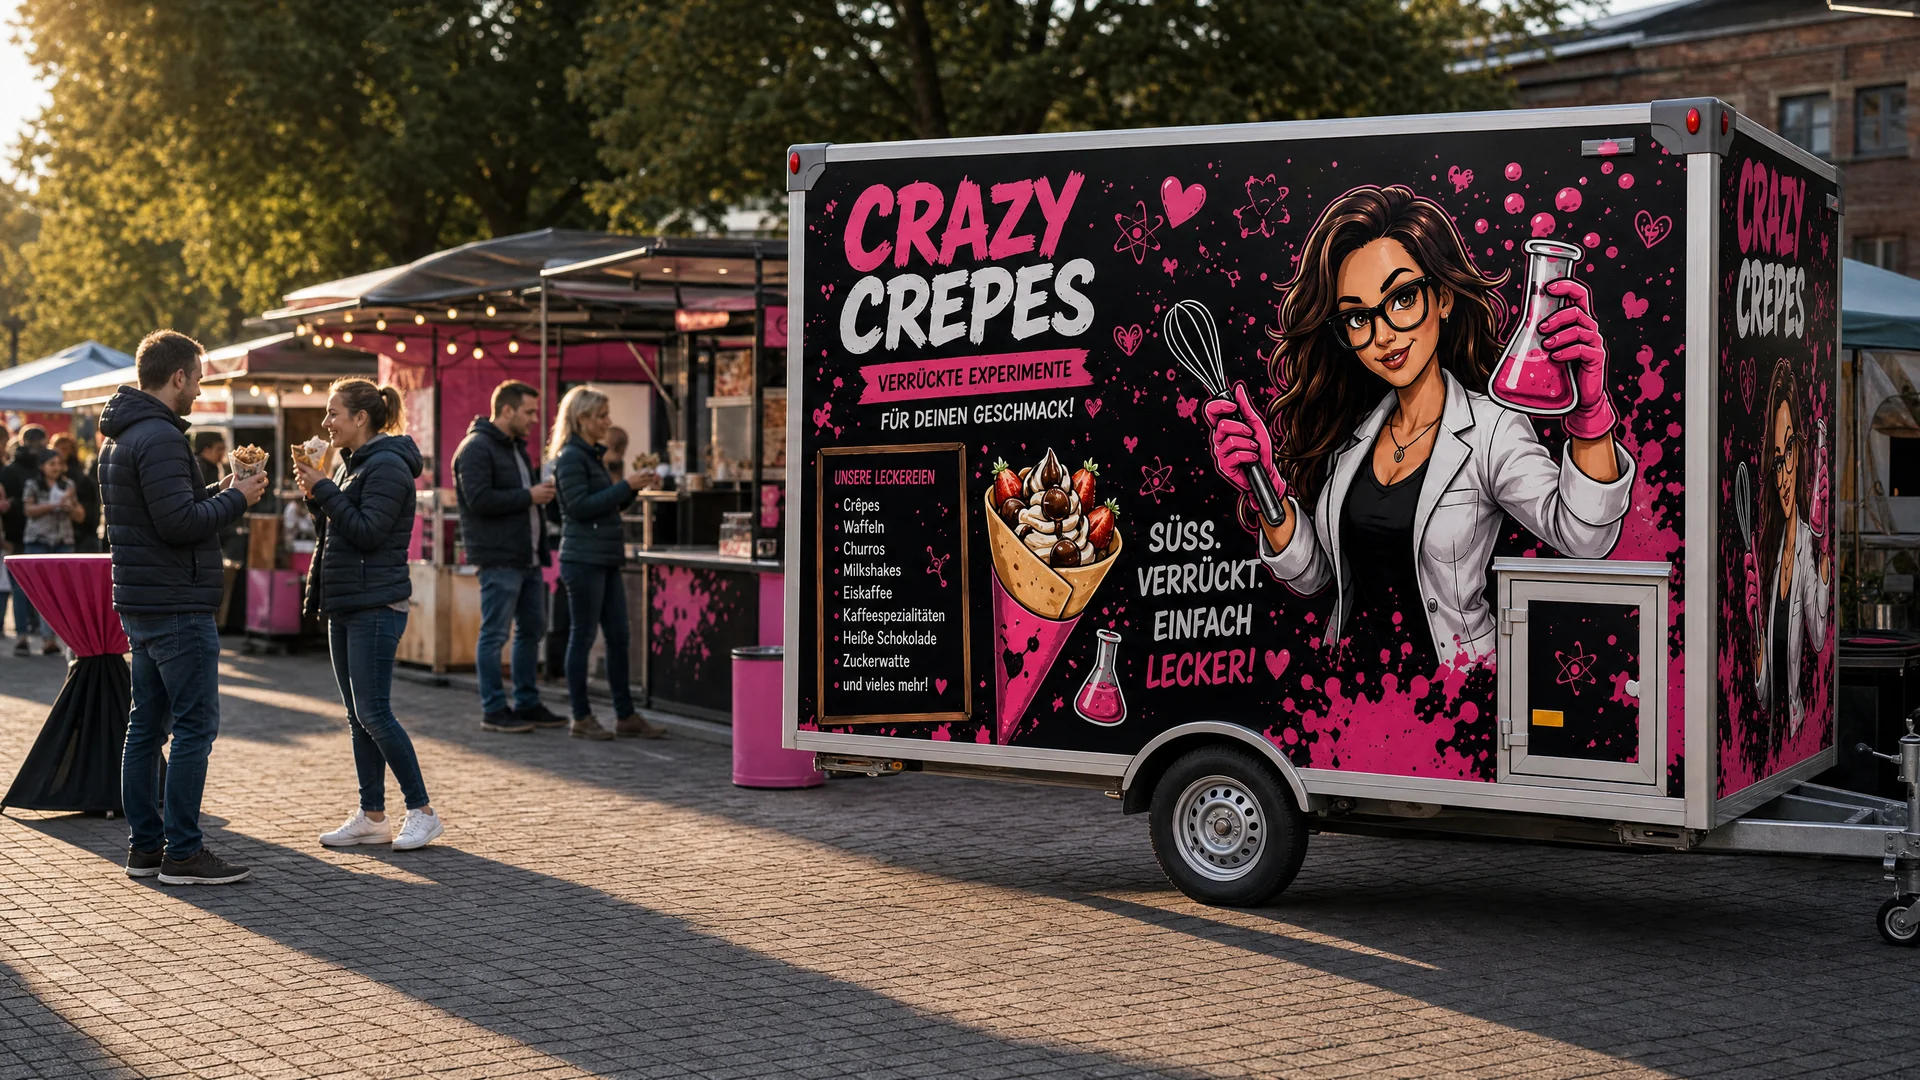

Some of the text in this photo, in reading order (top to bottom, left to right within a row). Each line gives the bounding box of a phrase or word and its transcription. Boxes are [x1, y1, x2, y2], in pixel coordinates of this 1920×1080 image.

[843, 170, 1085, 272] CRAZY
[1737, 157, 1806, 262] CRAZY
[840, 257, 1095, 354] CREPES
[1736, 257, 1805, 339] CREPES
[878, 360, 1072, 392] VERRÜCKTE EXPERIMENTE
[880, 397, 1075, 430] FÜR DEINEN GESCHMACK!
[834, 469, 935, 485] UNSERE LECKEREIEN
[843, 498, 880, 515] Crêpes
[843, 519, 885, 534] Waffeln
[1149, 514, 1221, 552] SÜSS.
[843, 541, 885, 556] Churros
[843, 563, 902, 577] Milkshakes
[1137, 556, 1263, 596] VERRÜCKT.
[843, 585, 893, 600] Eiskaffee
[843, 608, 945, 625] Kaffeespezialitäten
[1154, 603, 1253, 641] EINFACH
[843, 630, 937, 645] Heiße Schokolade
[843, 653, 910, 668] Zuckerwatte
[1146, 647, 1256, 689] LECKER!
[843, 676, 928, 691] und vieles mehr!
